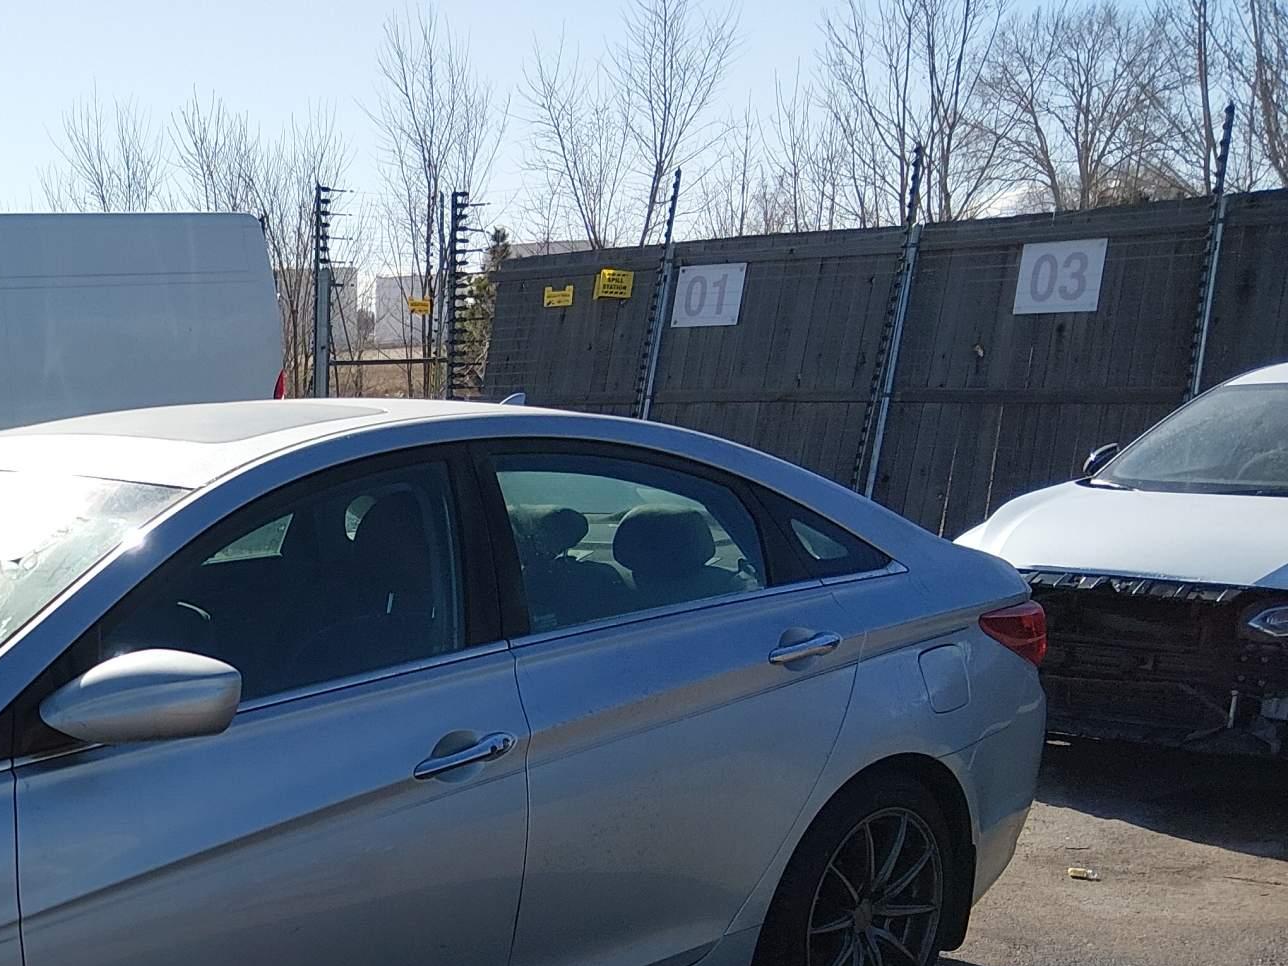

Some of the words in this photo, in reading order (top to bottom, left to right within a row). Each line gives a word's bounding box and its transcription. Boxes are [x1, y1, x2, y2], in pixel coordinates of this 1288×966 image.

[607, 276, 624, 284] SPILL
[684, 273, 728, 317] 01
[1030, 251, 1089, 302] 03
